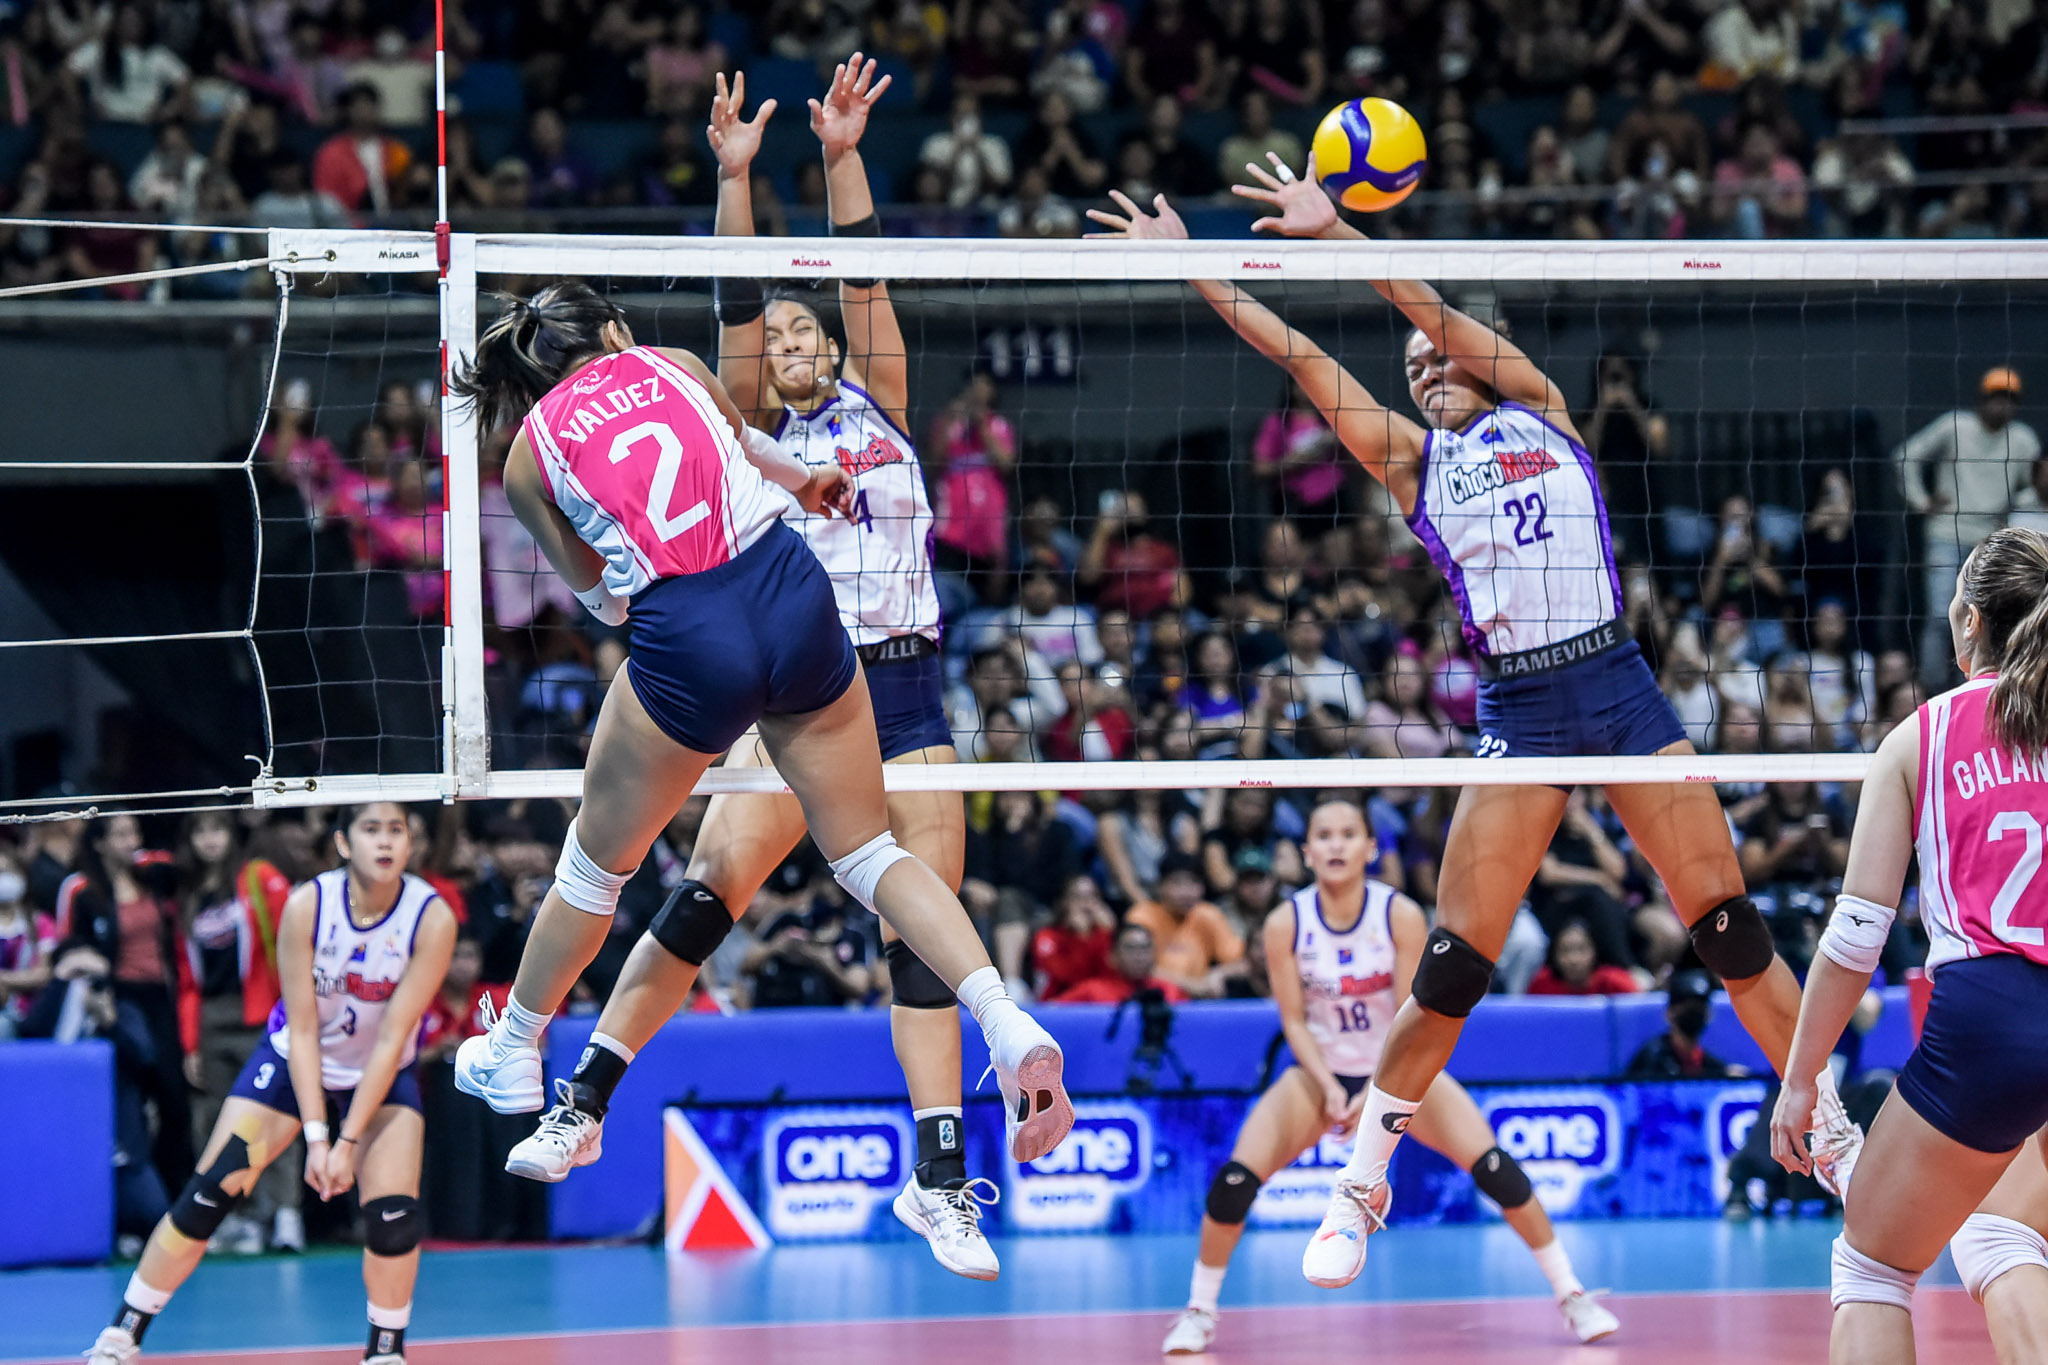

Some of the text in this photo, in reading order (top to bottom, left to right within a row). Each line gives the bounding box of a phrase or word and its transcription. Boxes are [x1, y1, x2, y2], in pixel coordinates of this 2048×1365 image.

[982, 332, 1074, 377] 111
[559, 375, 666, 444] VALDEZ
[607, 421, 712, 543] 2
[853, 488, 873, 533] 4
[1503, 493, 1554, 547] 22
[1501, 626, 1616, 675] GAMEVILLE
[1476, 734, 1509, 758] 22
[1335, 1001, 1371, 1033] 18
[253, 1062, 276, 1090] 3
[785, 1133, 893, 1181] one
[1497, 1113, 1600, 1159] one
